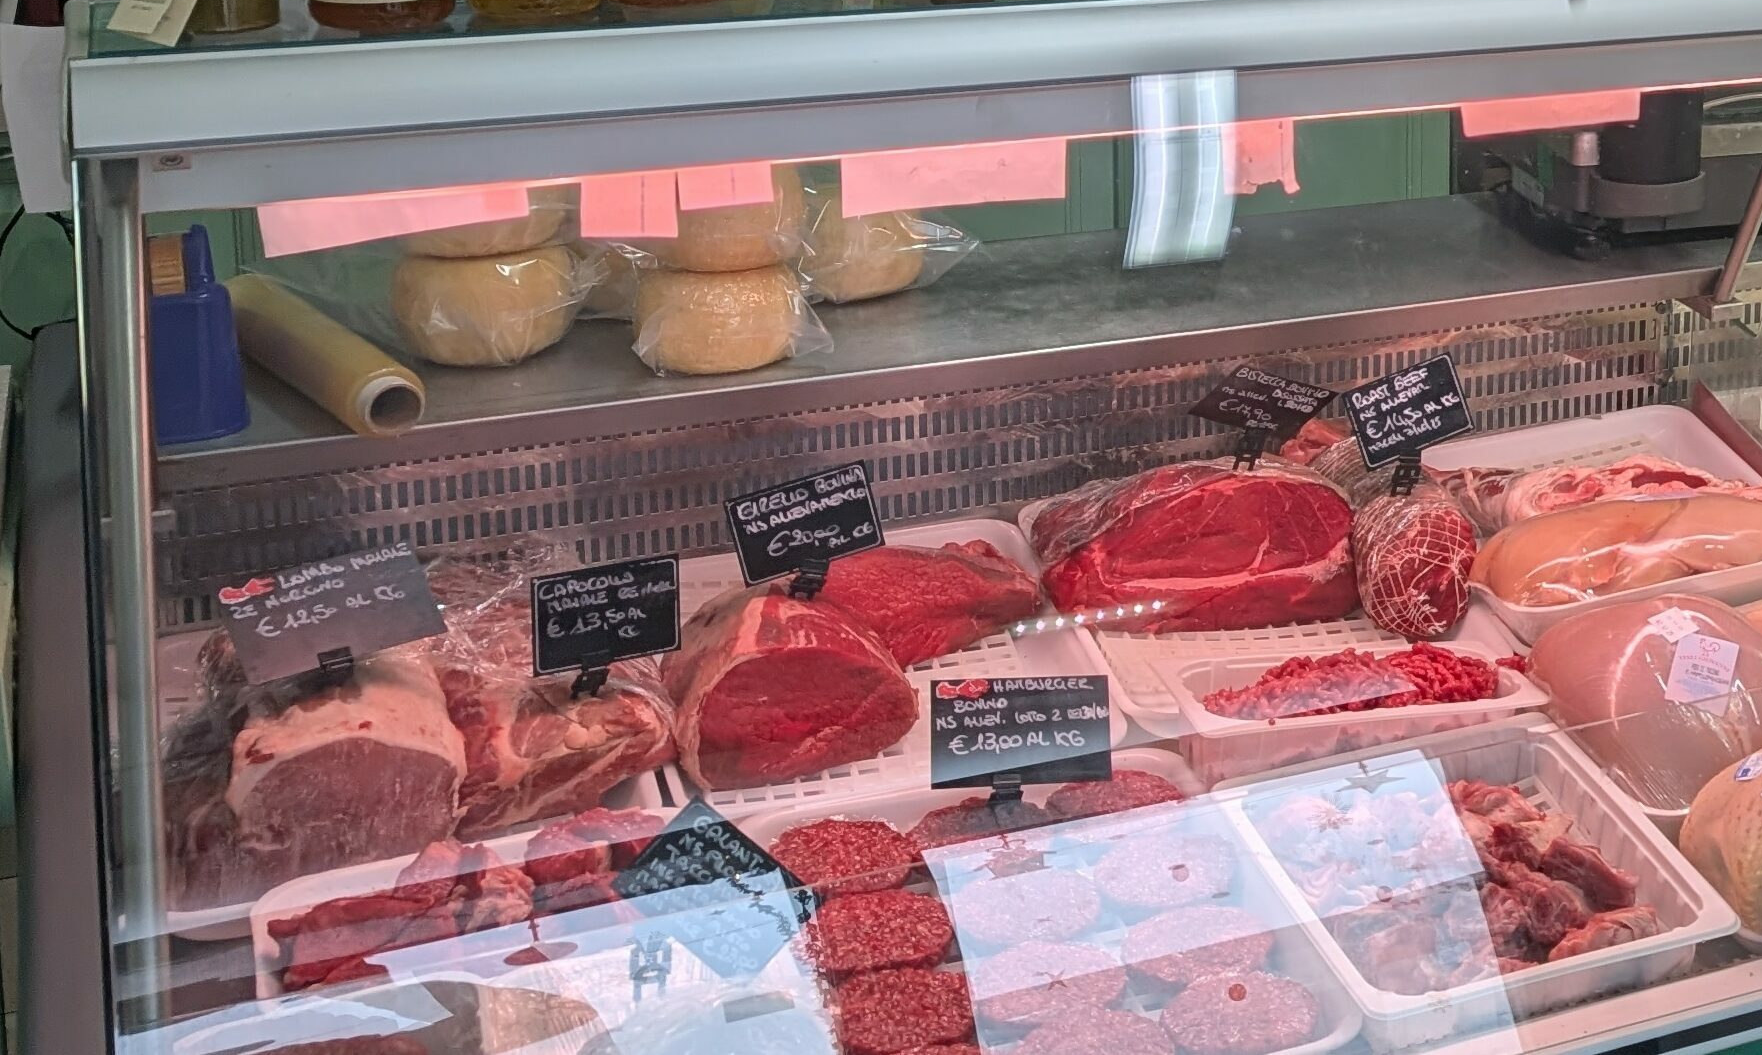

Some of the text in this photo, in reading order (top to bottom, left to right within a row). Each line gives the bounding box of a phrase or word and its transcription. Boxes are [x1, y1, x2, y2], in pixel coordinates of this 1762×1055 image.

[1236, 367, 1287, 389] BISTECCA
[1352, 368, 1428, 409] ROAST BEEF
[1219, 399, 1239, 411] €
[1366, 420, 1382, 438] €
[737, 488, 808, 520] GIRELLO
[767, 531, 791, 557] €
[829, 535, 850, 548] AL
[278, 563, 345, 589] LOMBO
[255, 616, 281, 638] €
[283, 604, 339, 629] 12,50
[547, 607, 646, 638] € 13,50 AL
[993, 678, 1093, 693] HAMBURGER
[954, 698, 1008, 713] BOVINO
[936, 716, 957, 731] NS
[964, 712, 1006, 727] ALLEV.
[1015, 711, 1047, 724] LOTTO
[948, 729, 1085, 755] € 13,00 AL KG
